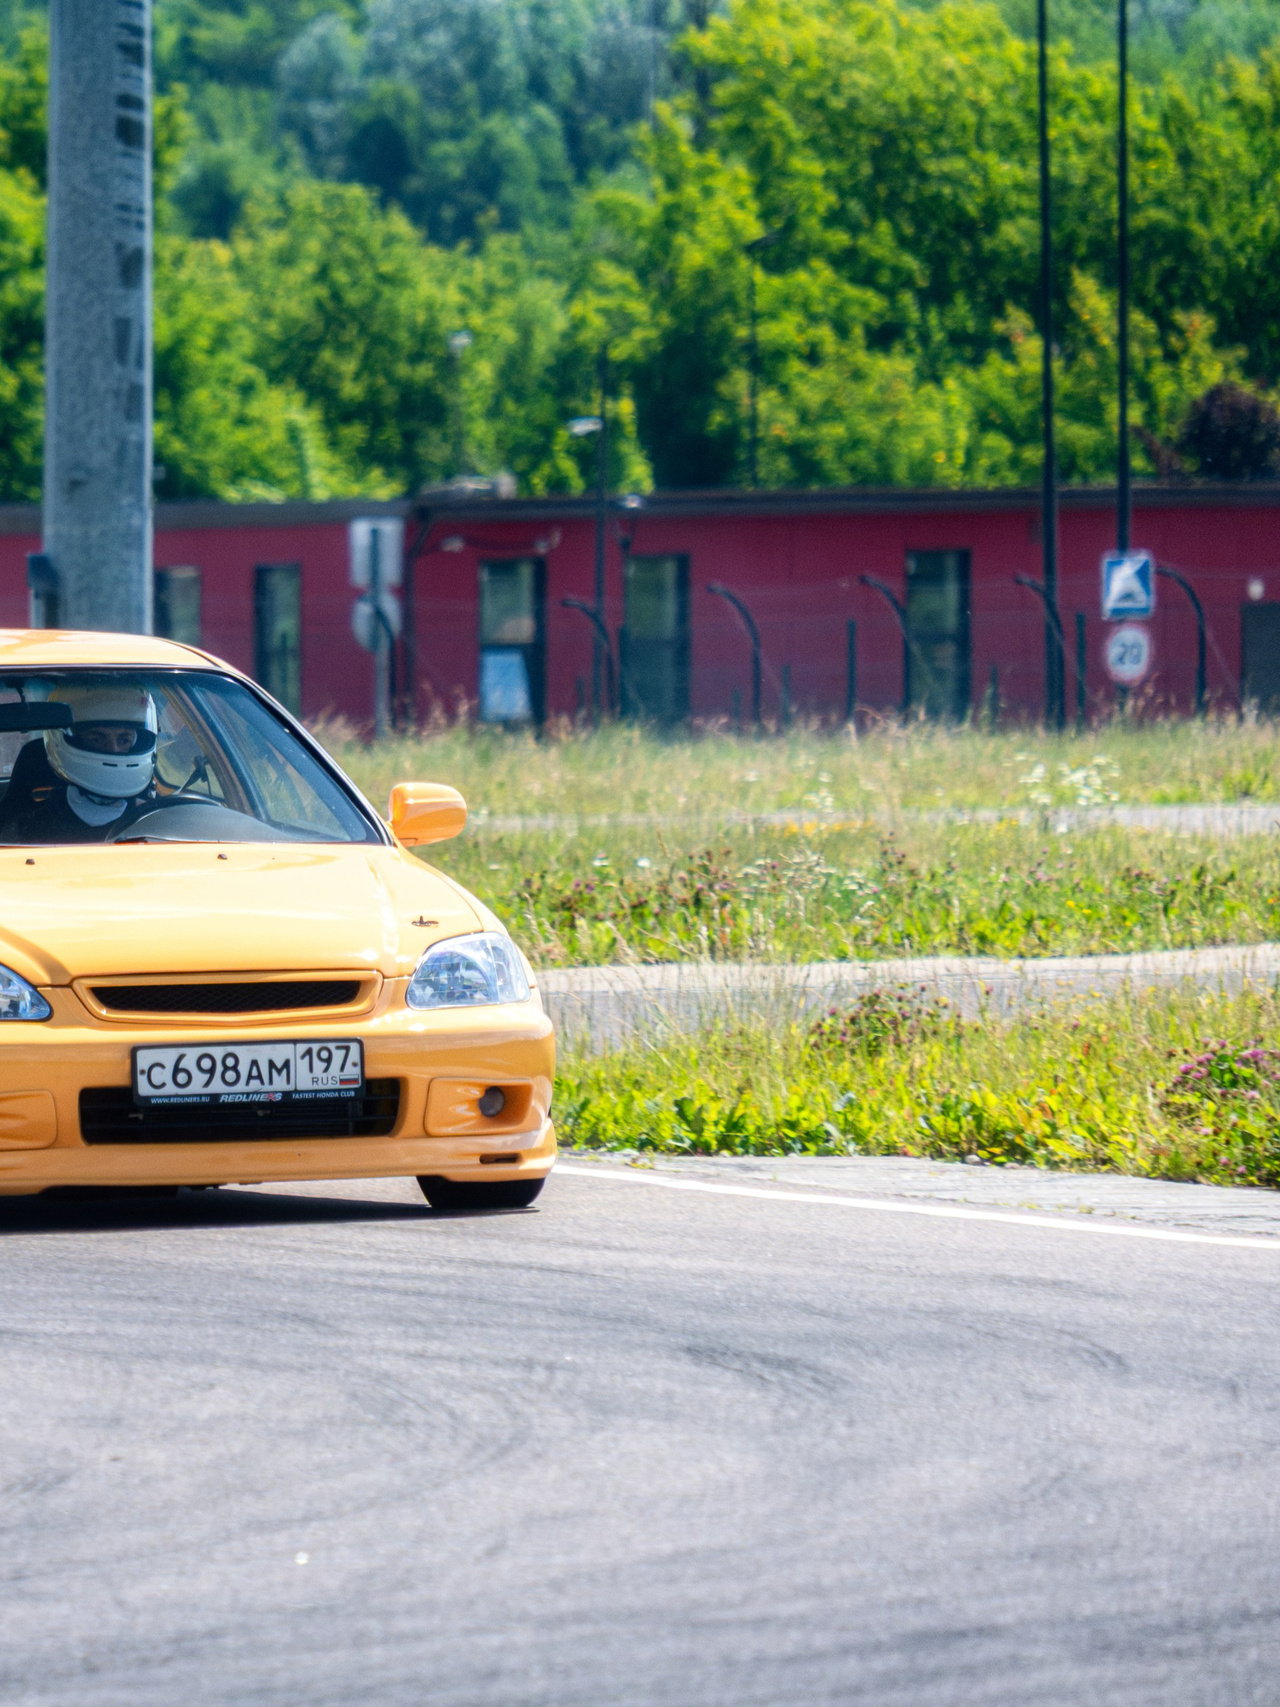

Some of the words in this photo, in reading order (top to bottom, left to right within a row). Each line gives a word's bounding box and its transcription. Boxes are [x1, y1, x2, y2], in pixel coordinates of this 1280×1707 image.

[1114, 642, 1143, 666] 20
[300, 1045, 351, 1074] 197
[312, 1075, 338, 1086] RUS
[219, 1092, 283, 1103] REDLINERS
[316, 1091, 339, 1099] HONDA
